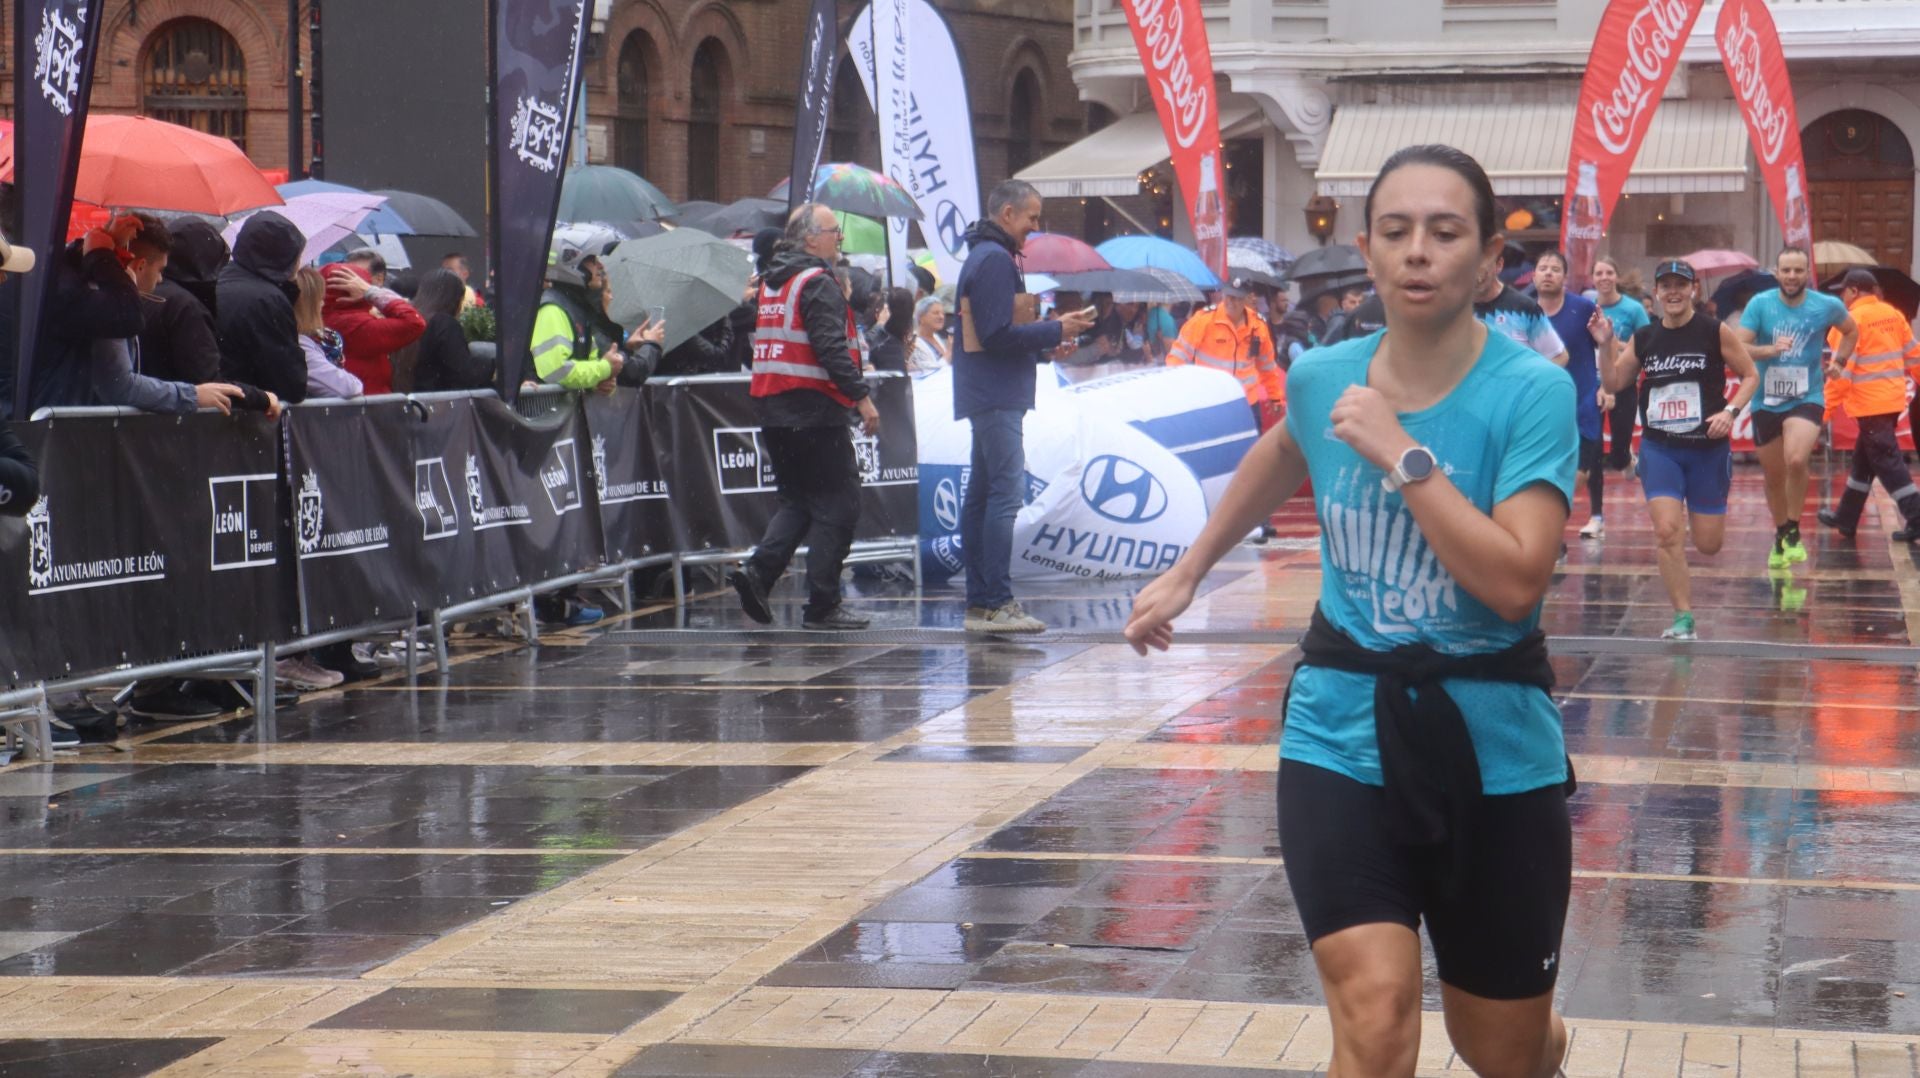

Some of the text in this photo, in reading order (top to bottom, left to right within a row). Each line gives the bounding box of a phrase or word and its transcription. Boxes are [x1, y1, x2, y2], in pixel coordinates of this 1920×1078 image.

[1773, 380, 1798, 396] 1021
[1658, 400, 1687, 421] 709
[720, 447, 756, 469] LEÓN
[882, 467, 919, 480] AYUNTA
[636, 481, 649, 494] DE
[215, 504, 244, 534] LEÓN
[249, 529, 258, 539] ES
[53, 550, 165, 583] AYUNTAMIENTO DE LEÓN
[1021, 549, 1091, 578] Lemauto
